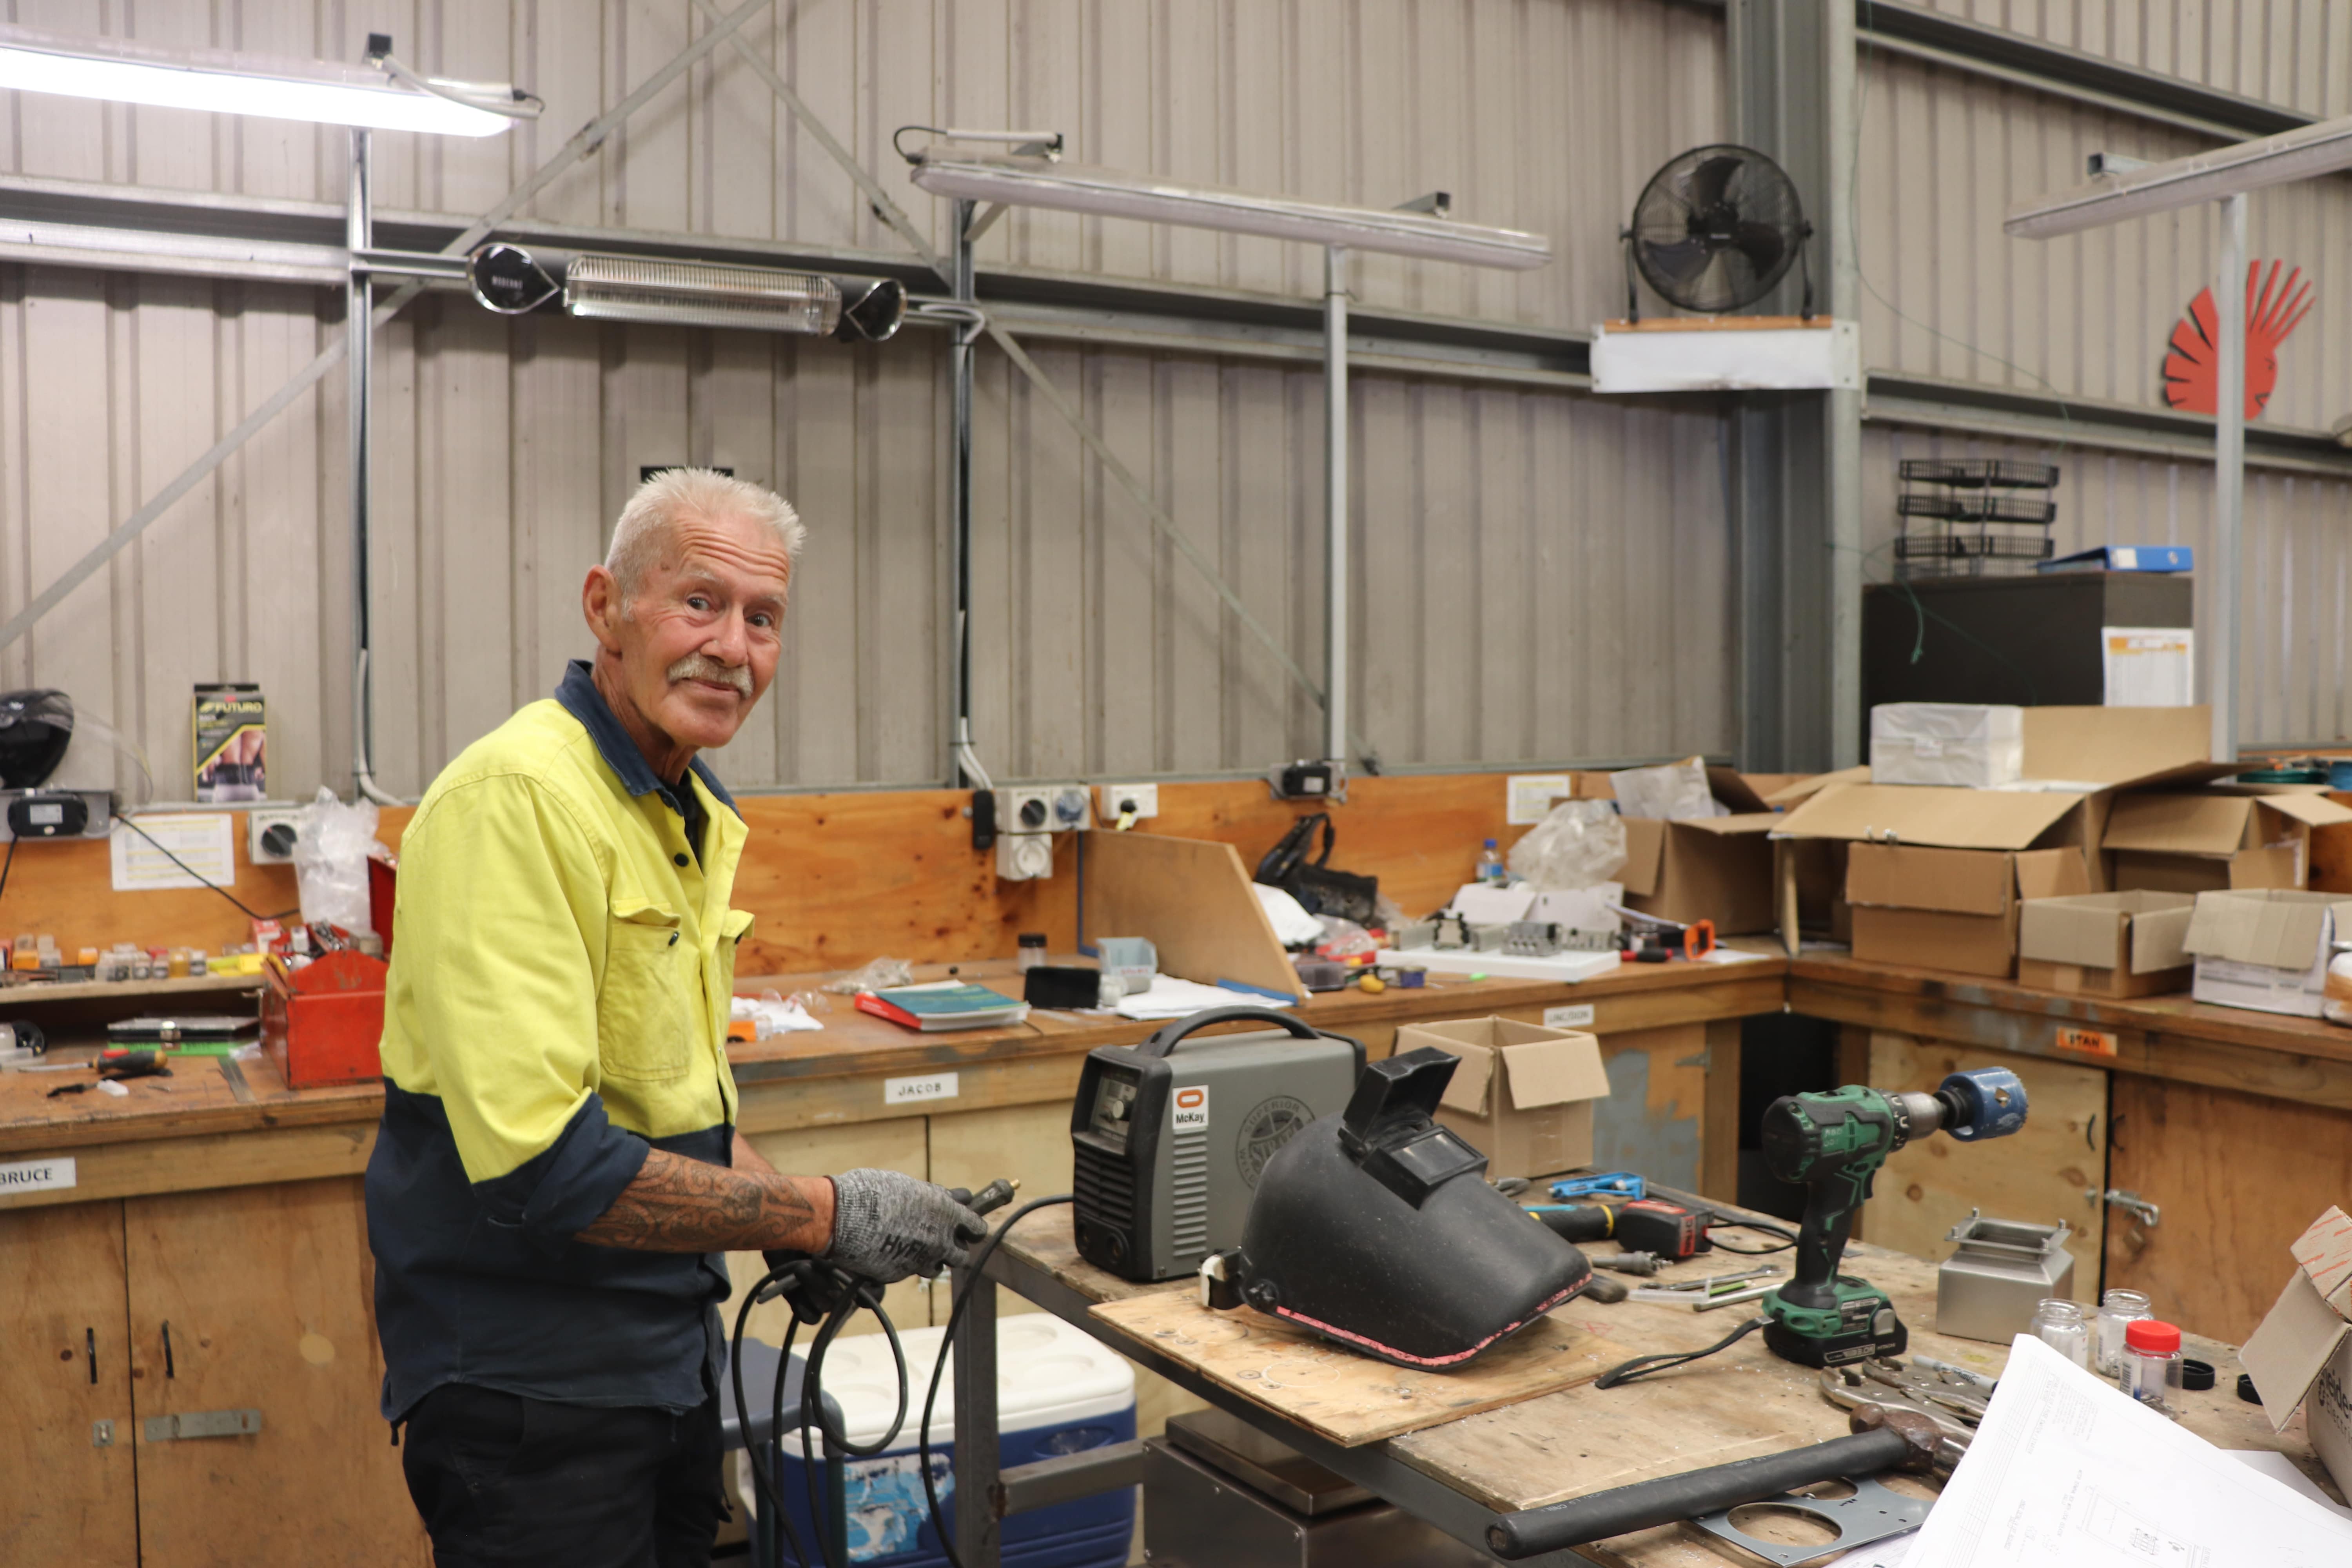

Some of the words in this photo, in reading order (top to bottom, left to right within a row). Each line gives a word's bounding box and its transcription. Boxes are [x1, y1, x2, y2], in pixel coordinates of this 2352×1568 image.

[215, 701, 262, 713] FUTURO
[898, 1083, 941, 1096] JACOB
[1176, 1112, 1205, 1123] McKay
[1243, 1100, 1300, 1133] SUPERIOR
[0, 1167, 53, 1185] BRUCE
